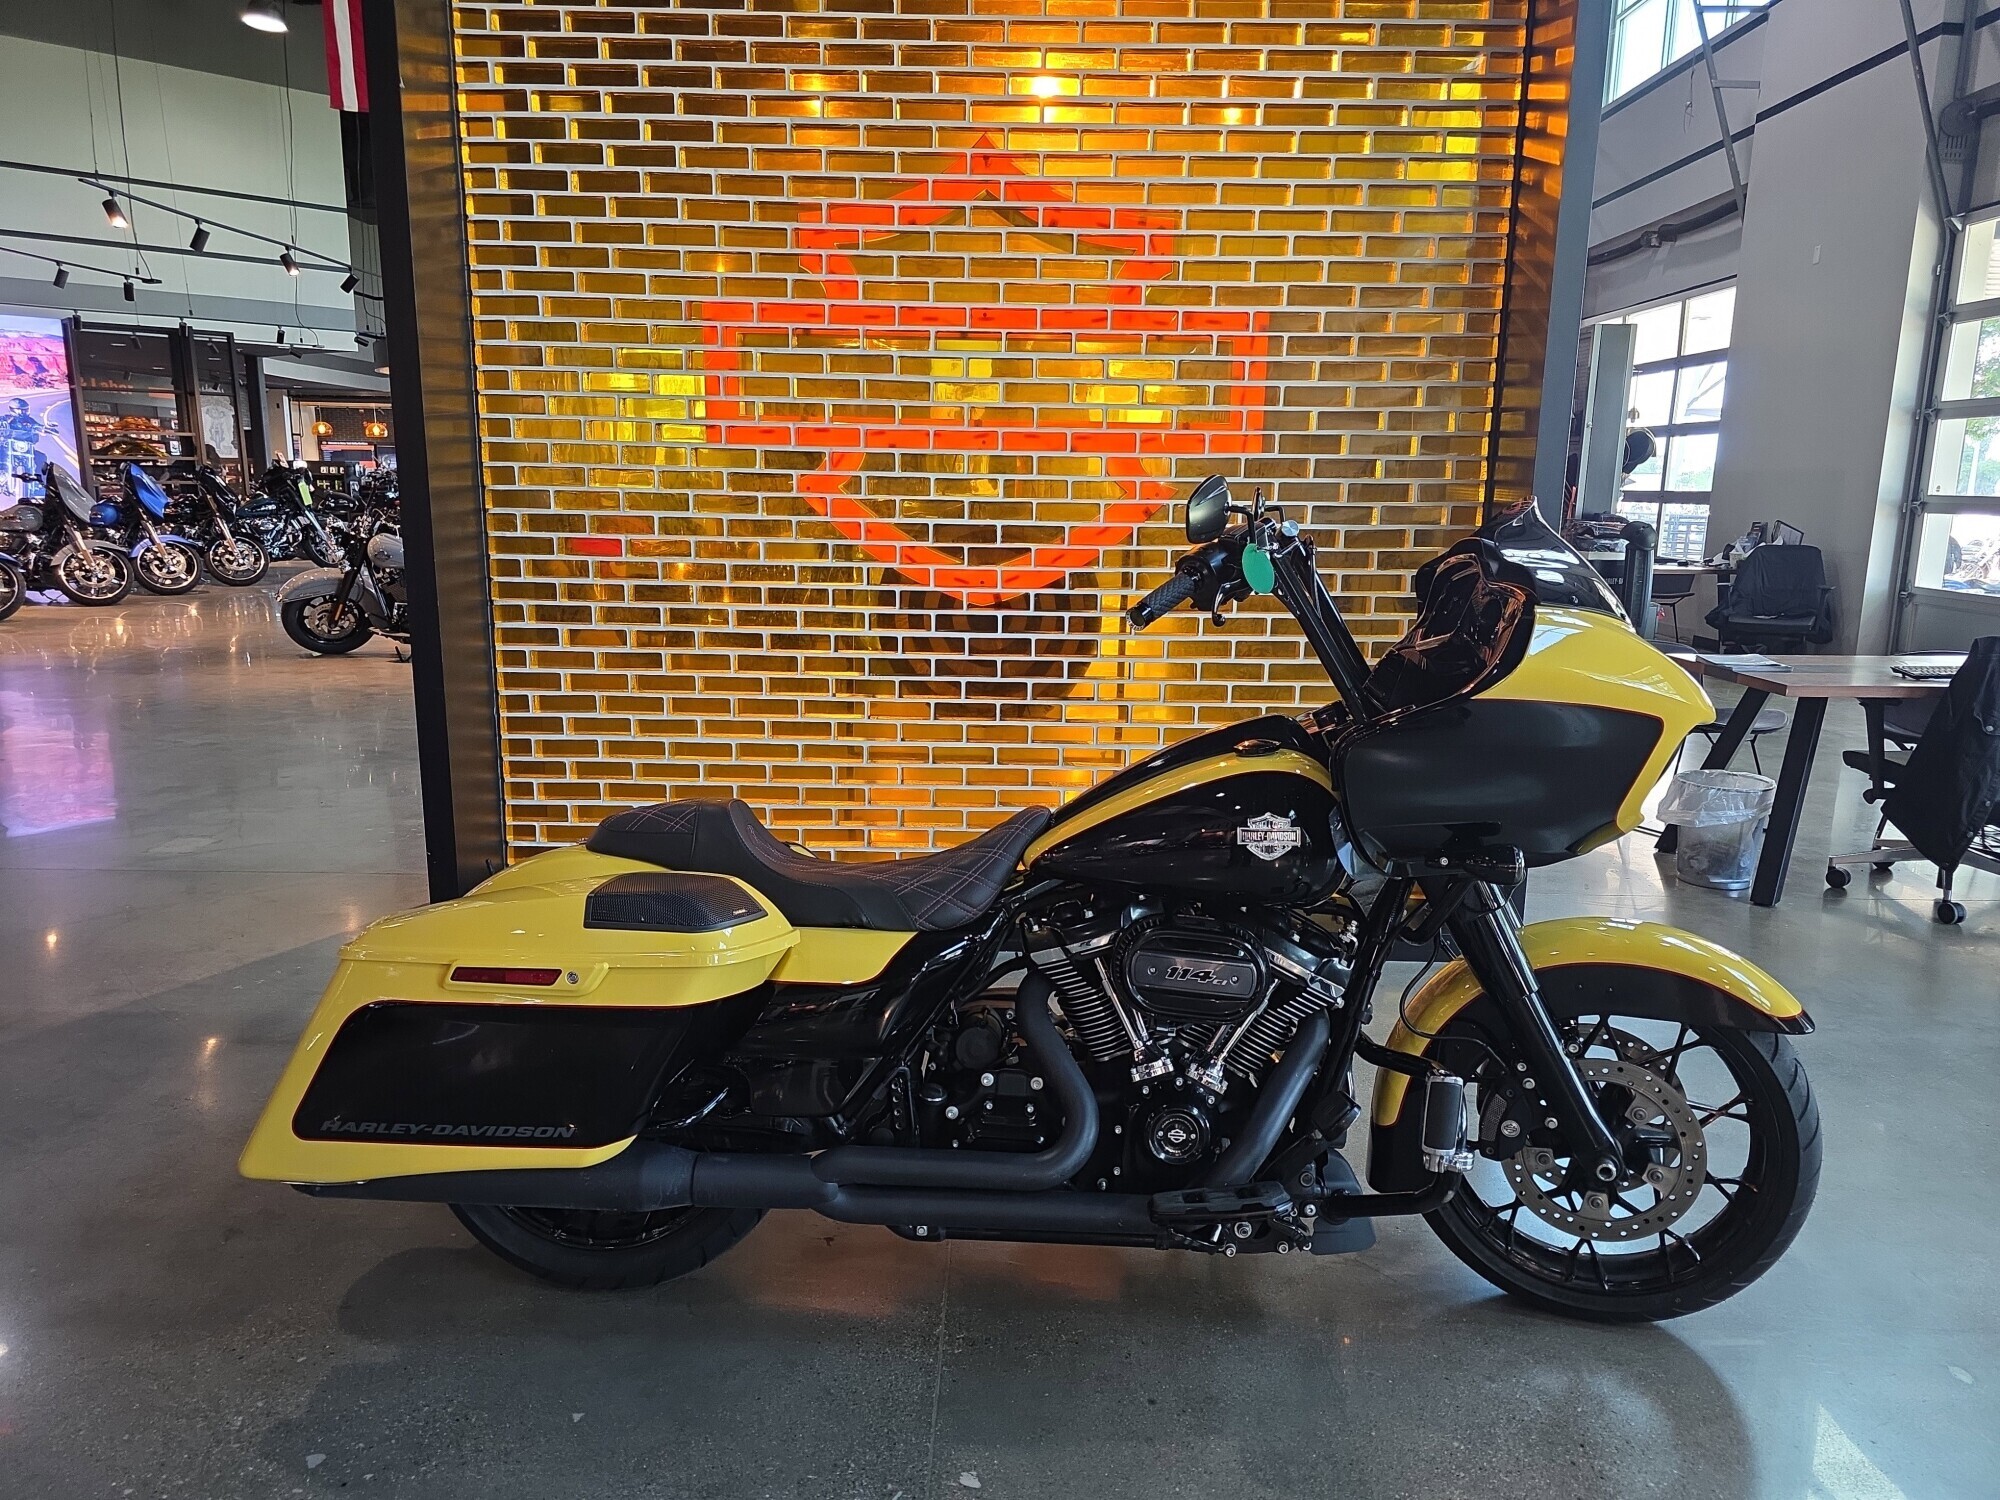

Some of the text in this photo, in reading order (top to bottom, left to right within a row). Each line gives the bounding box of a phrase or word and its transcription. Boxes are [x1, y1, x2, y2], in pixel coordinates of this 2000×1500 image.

[1242, 831, 1296, 841] HARLEY-DAVIDSON
[1165, 965, 1217, 983] 114
[320, 1120, 576, 1138] HARLEY-DAVIDSON
